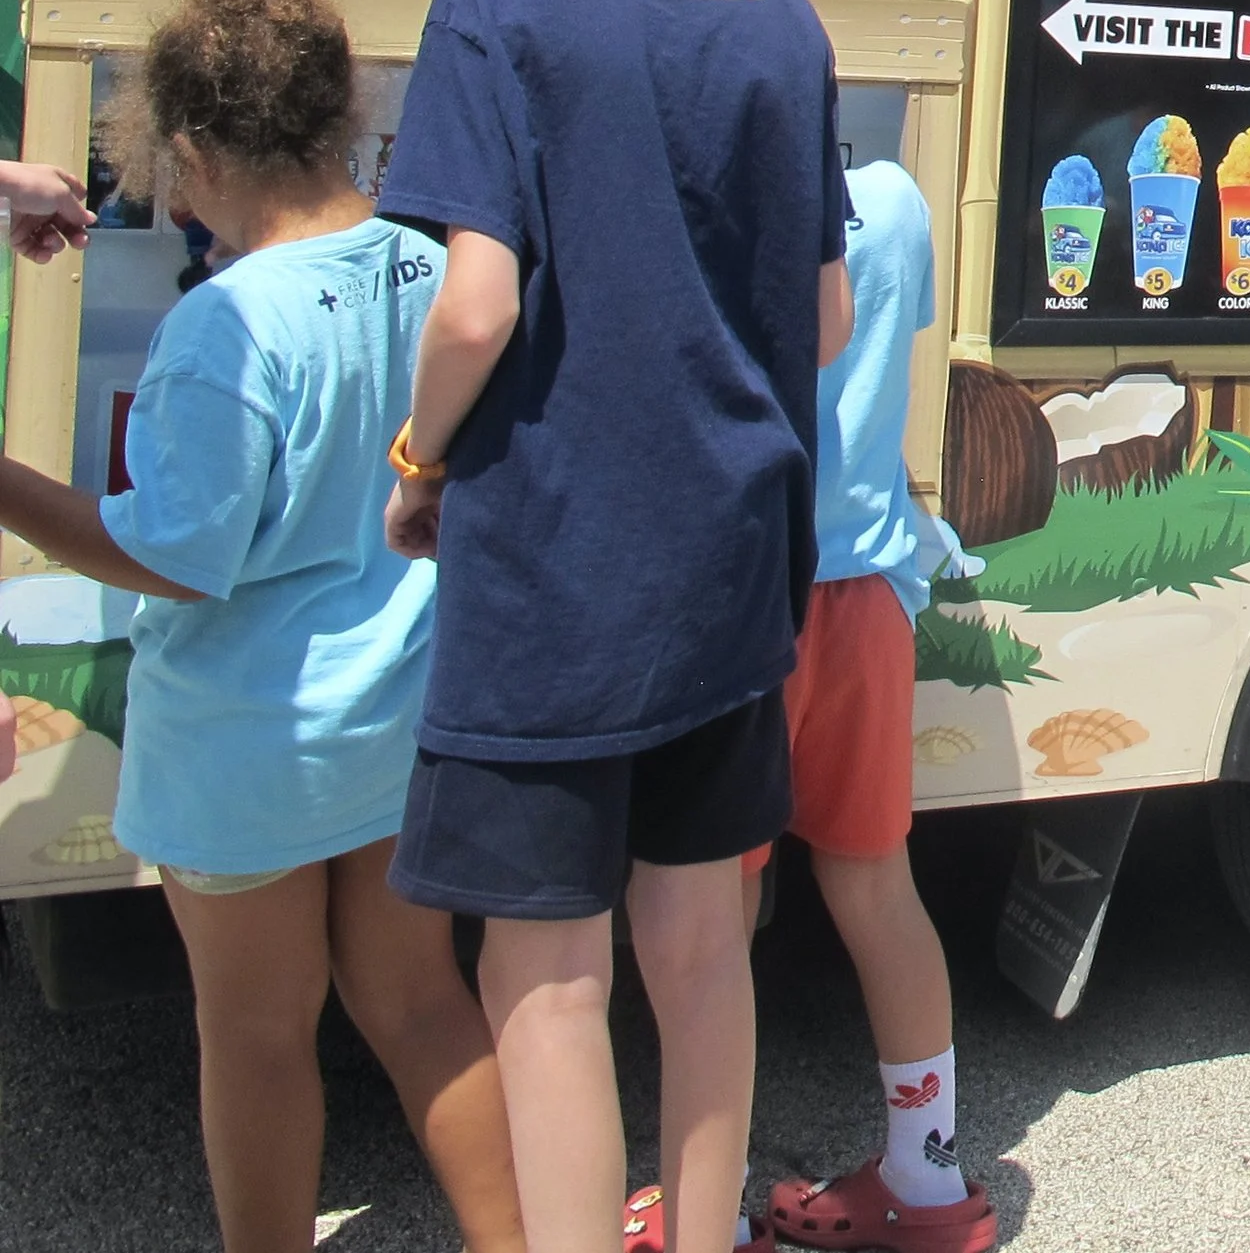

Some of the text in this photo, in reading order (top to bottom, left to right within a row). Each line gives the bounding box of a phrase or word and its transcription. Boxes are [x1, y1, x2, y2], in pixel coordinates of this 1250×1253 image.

[1074, 13, 1154, 46] VISIT
[1165, 19, 1223, 49] THE
[338, 279, 367, 295] FREE
[1060, 274, 1077, 292] $4
[1146, 273, 1165, 291] $5
[1231, 273, 1250, 289] $6
[1045, 297, 1089, 309] KLASSIC
[1142, 297, 1169, 309] KING
